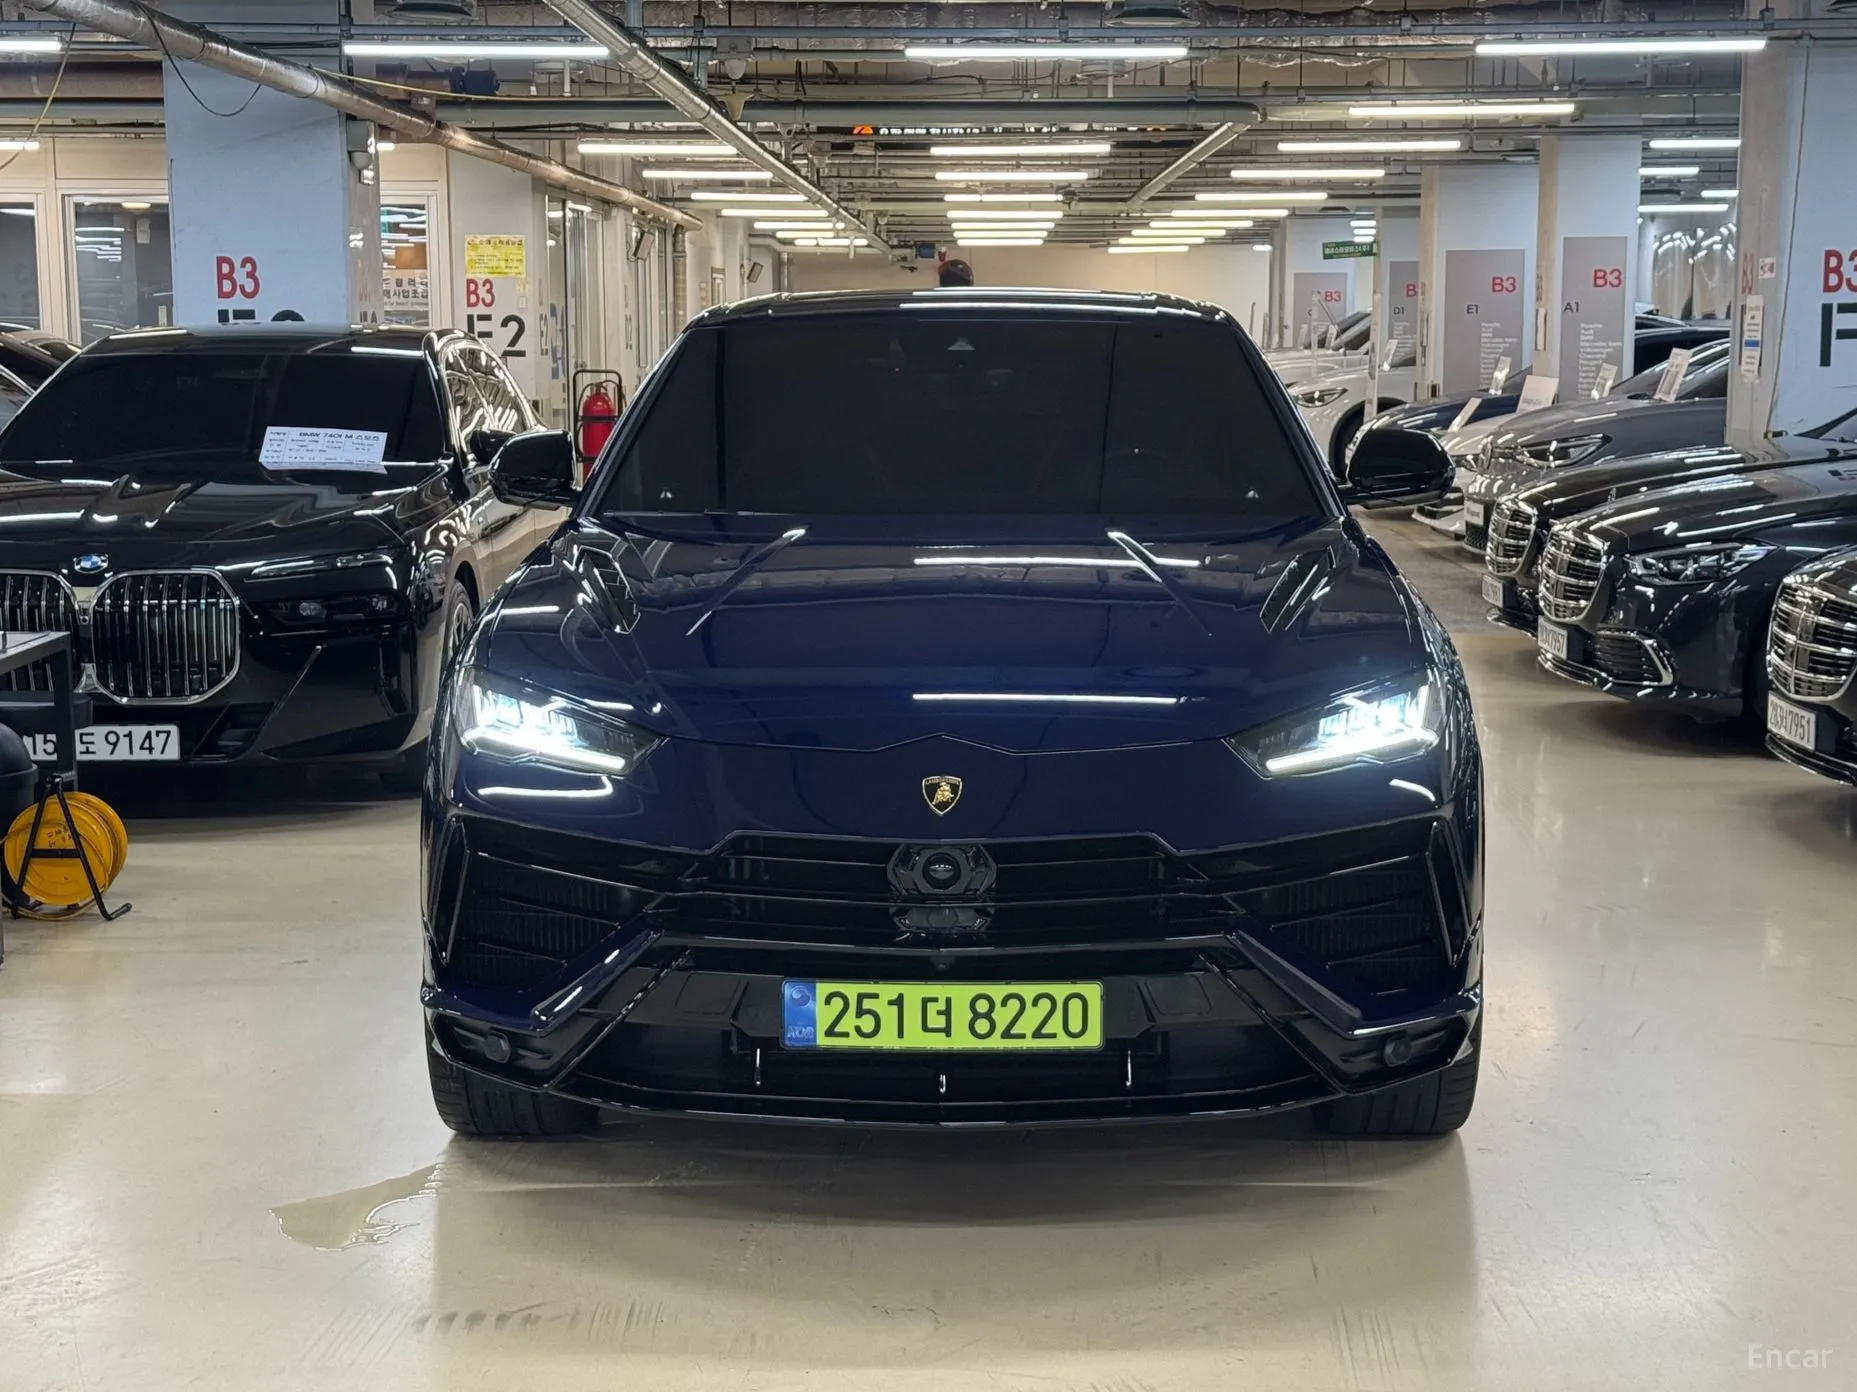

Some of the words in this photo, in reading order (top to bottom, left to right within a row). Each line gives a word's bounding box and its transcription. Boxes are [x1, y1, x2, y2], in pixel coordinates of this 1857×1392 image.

[216, 256, 260, 299] B3
[1593, 268, 1623, 288] B3
[1823, 249, 1857, 293] B3
[466, 278, 495, 308] B3
[1406, 283, 1418, 297] B
[1492, 276, 1517, 293] B3
[1324, 291, 1342, 302] B3
[1466, 304, 1479, 314] E1
[1563, 302, 1580, 313] A1
[104, 730, 171, 756] 9147
[823, 990, 952, 1039] 251더
[968, 991, 1089, 1040] 8220
